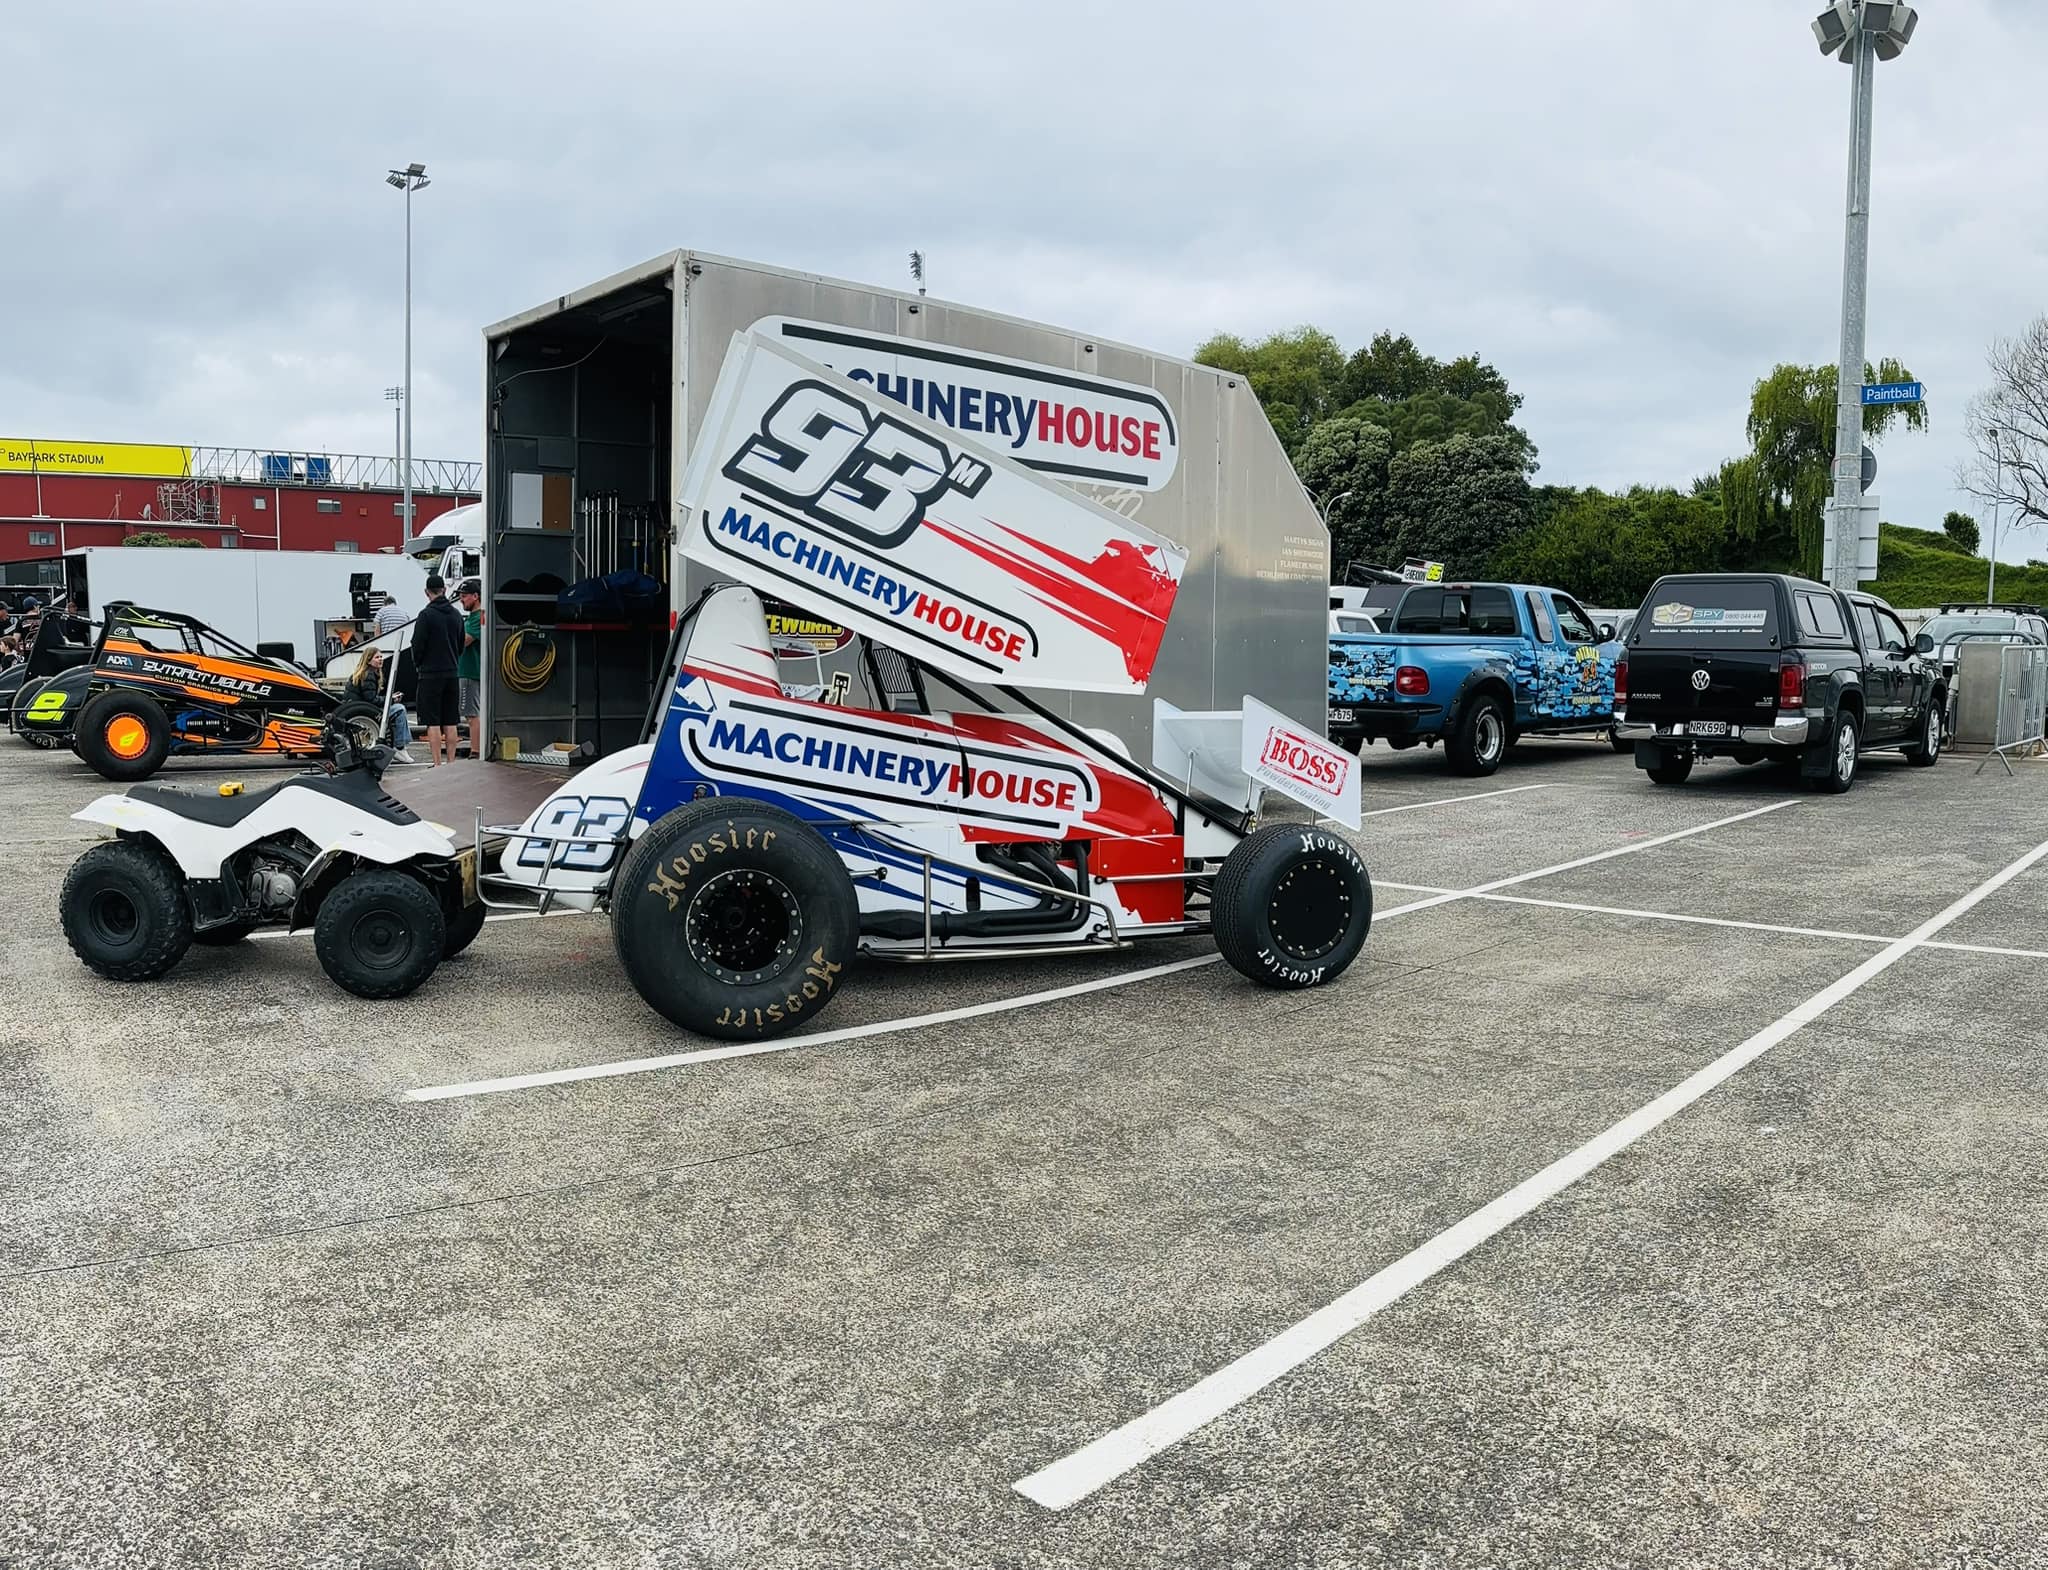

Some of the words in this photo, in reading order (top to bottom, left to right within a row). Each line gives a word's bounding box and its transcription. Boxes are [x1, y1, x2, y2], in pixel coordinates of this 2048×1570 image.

[1866, 386, 1917, 401] Paintball
[8, 452, 56, 463] BAYPARK
[58, 454, 104, 464] STADIUM
[1693, 610, 1721, 618] SPY
[142, 660, 212, 685] EXTRACT
[1269, 737, 1338, 783] BOSS
[1256, 766, 1333, 810] Powdercoating
[648, 820, 777, 912] Hoosier
[1300, 833, 1365, 873] Hoosier
[1257, 949, 1326, 984] Hoosier
[715, 946, 842, 1032] Hoosier
